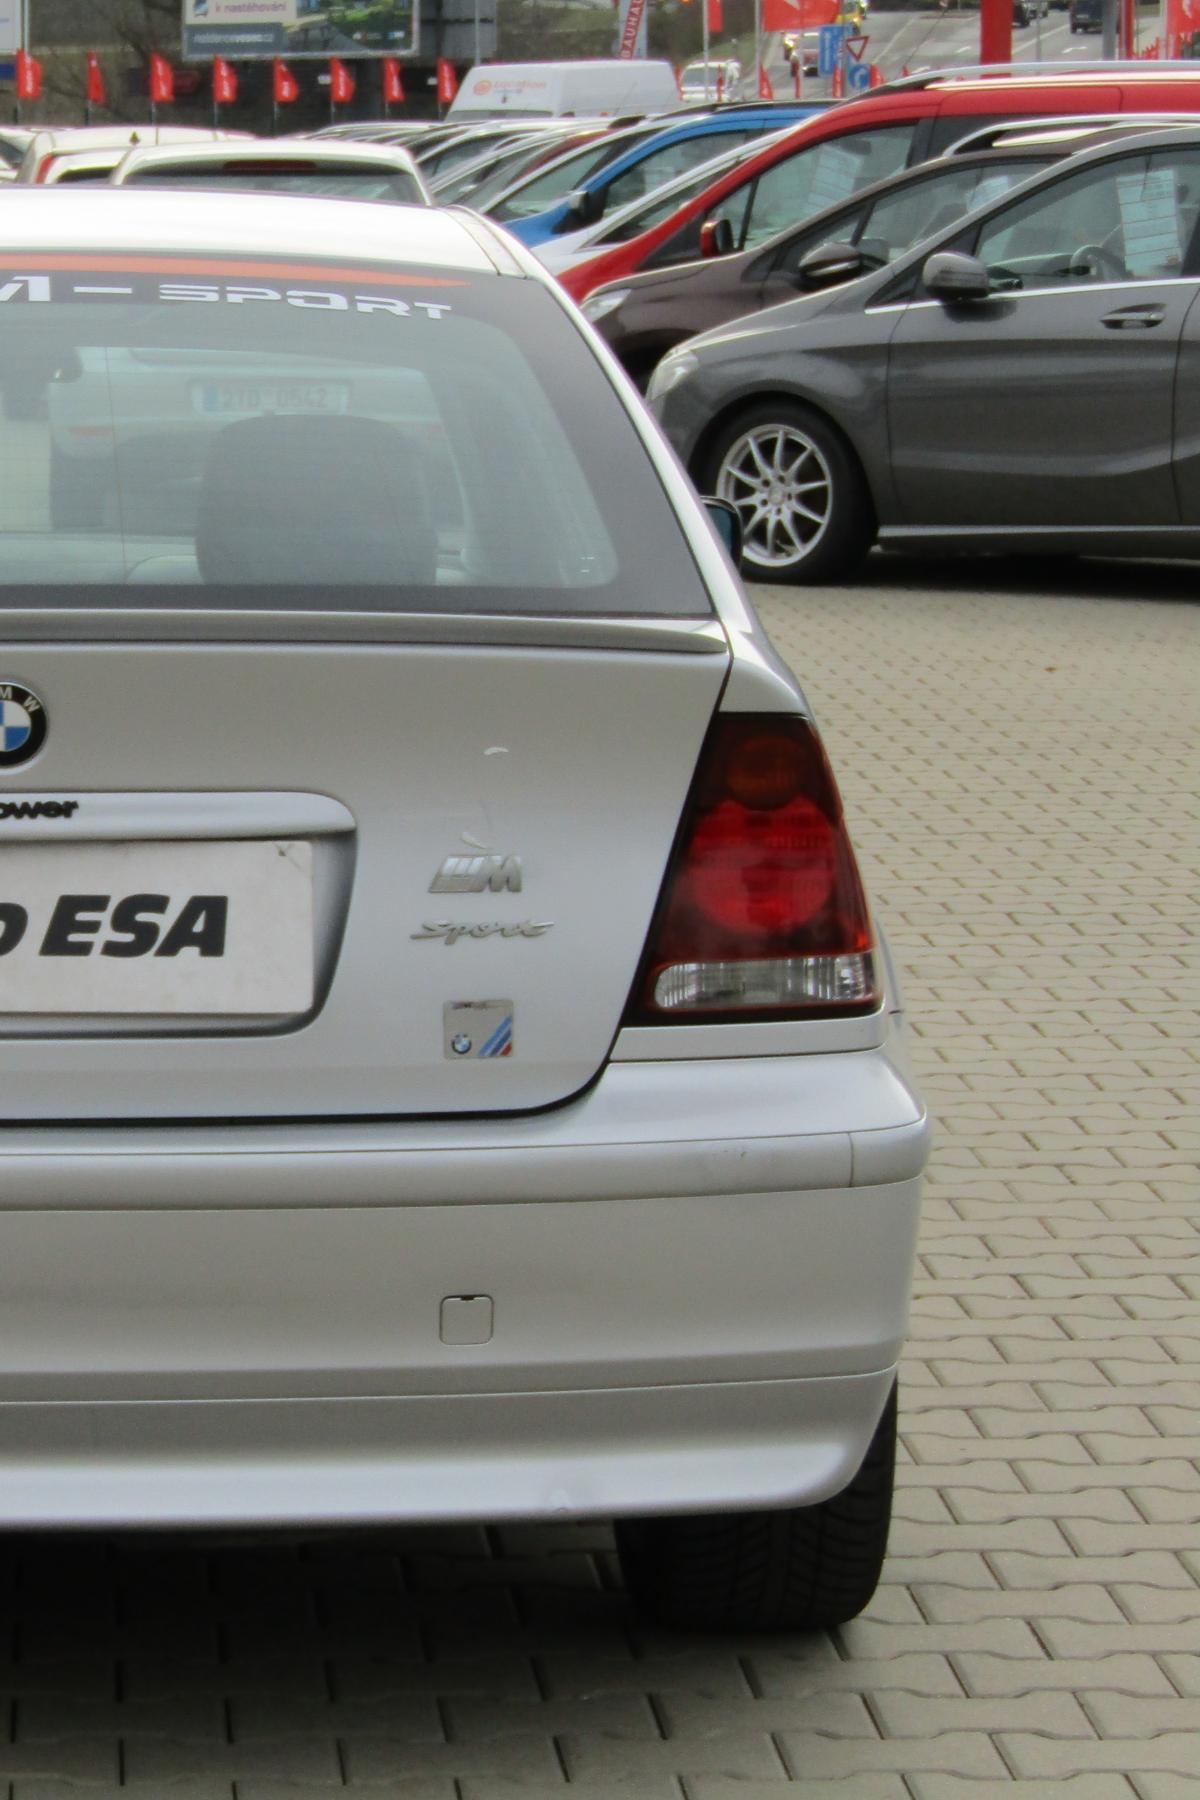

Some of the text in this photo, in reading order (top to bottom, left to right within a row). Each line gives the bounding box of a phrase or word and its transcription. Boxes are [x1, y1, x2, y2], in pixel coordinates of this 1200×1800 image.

[158, 283, 452, 319] SPORT
[38, 893, 229, 958] ESA
[410, 920, 555, 945] Sport
